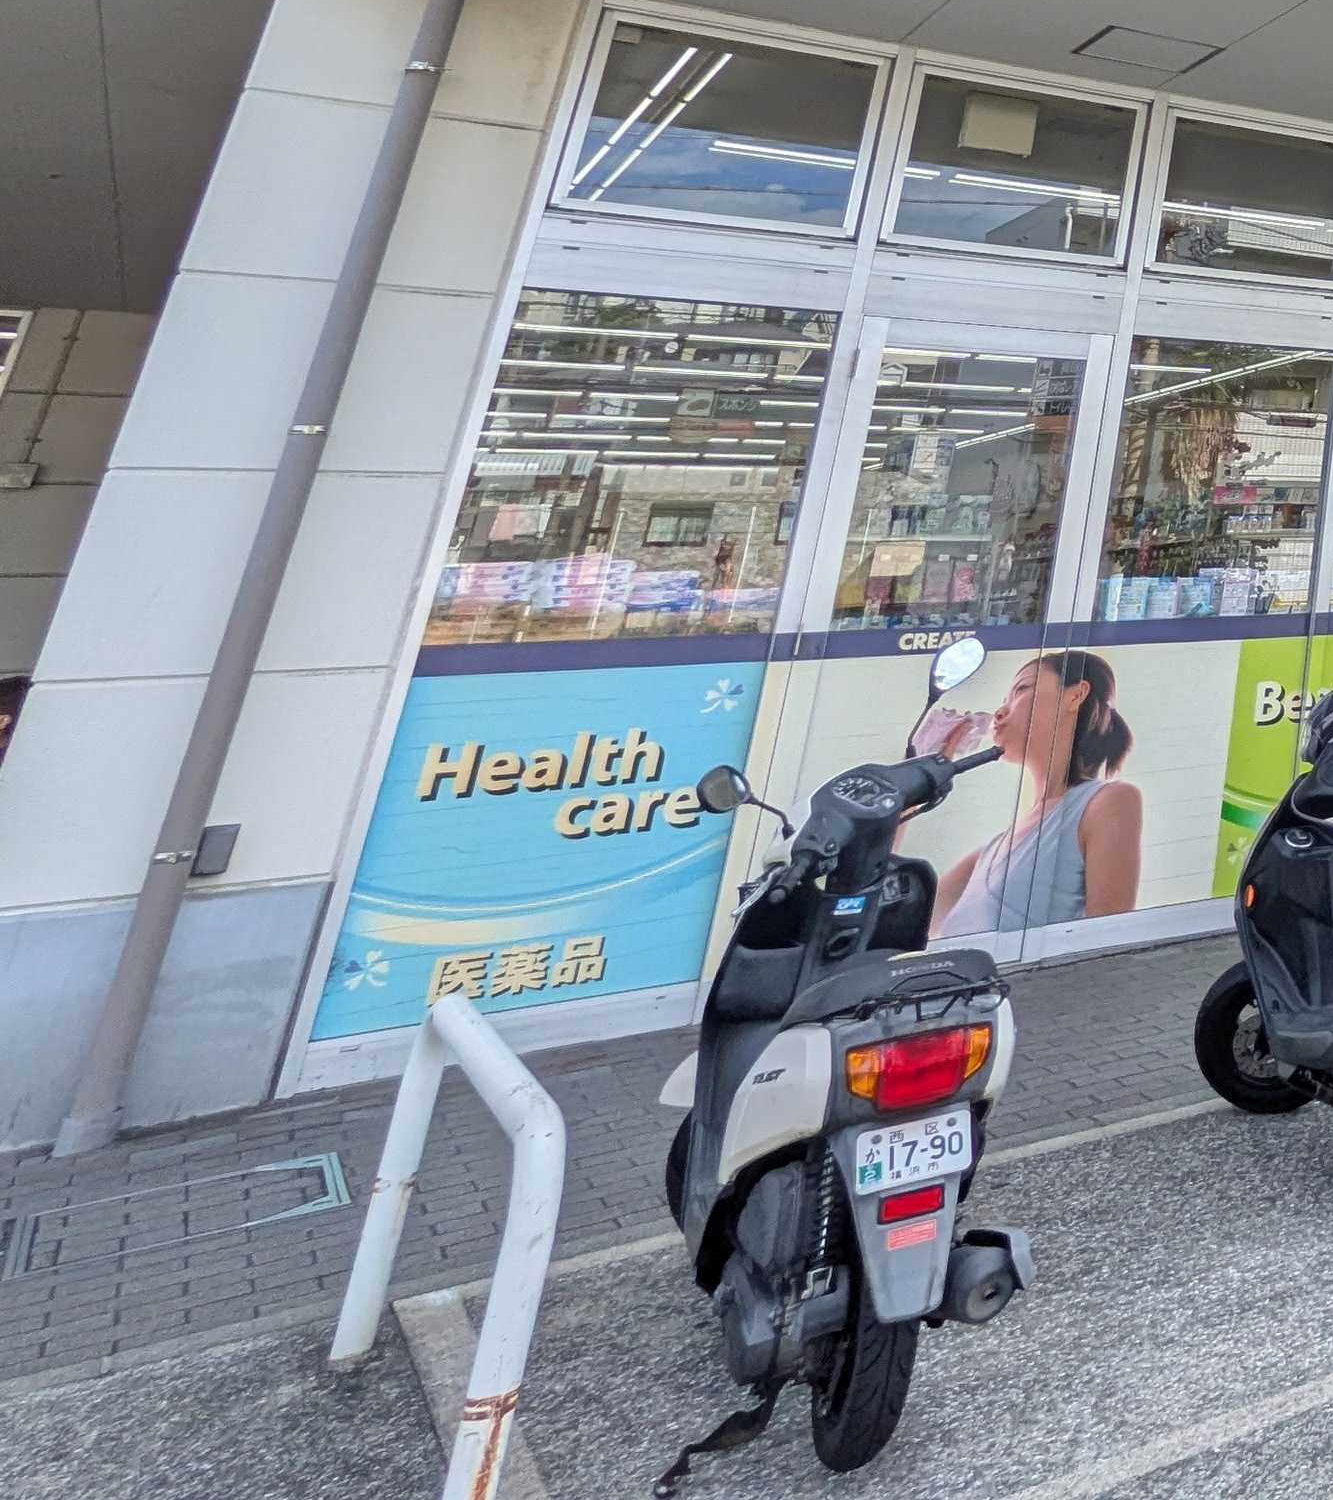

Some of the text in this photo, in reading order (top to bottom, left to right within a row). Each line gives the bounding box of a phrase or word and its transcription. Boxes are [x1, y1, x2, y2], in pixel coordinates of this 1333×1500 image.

[898, 631, 976, 651] CREA
[416, 727, 664, 801] Health
[555, 786, 700, 839] care
[428, 935, 606, 1004] 医薬品
[865, 1131, 963, 1171] か 17-90
